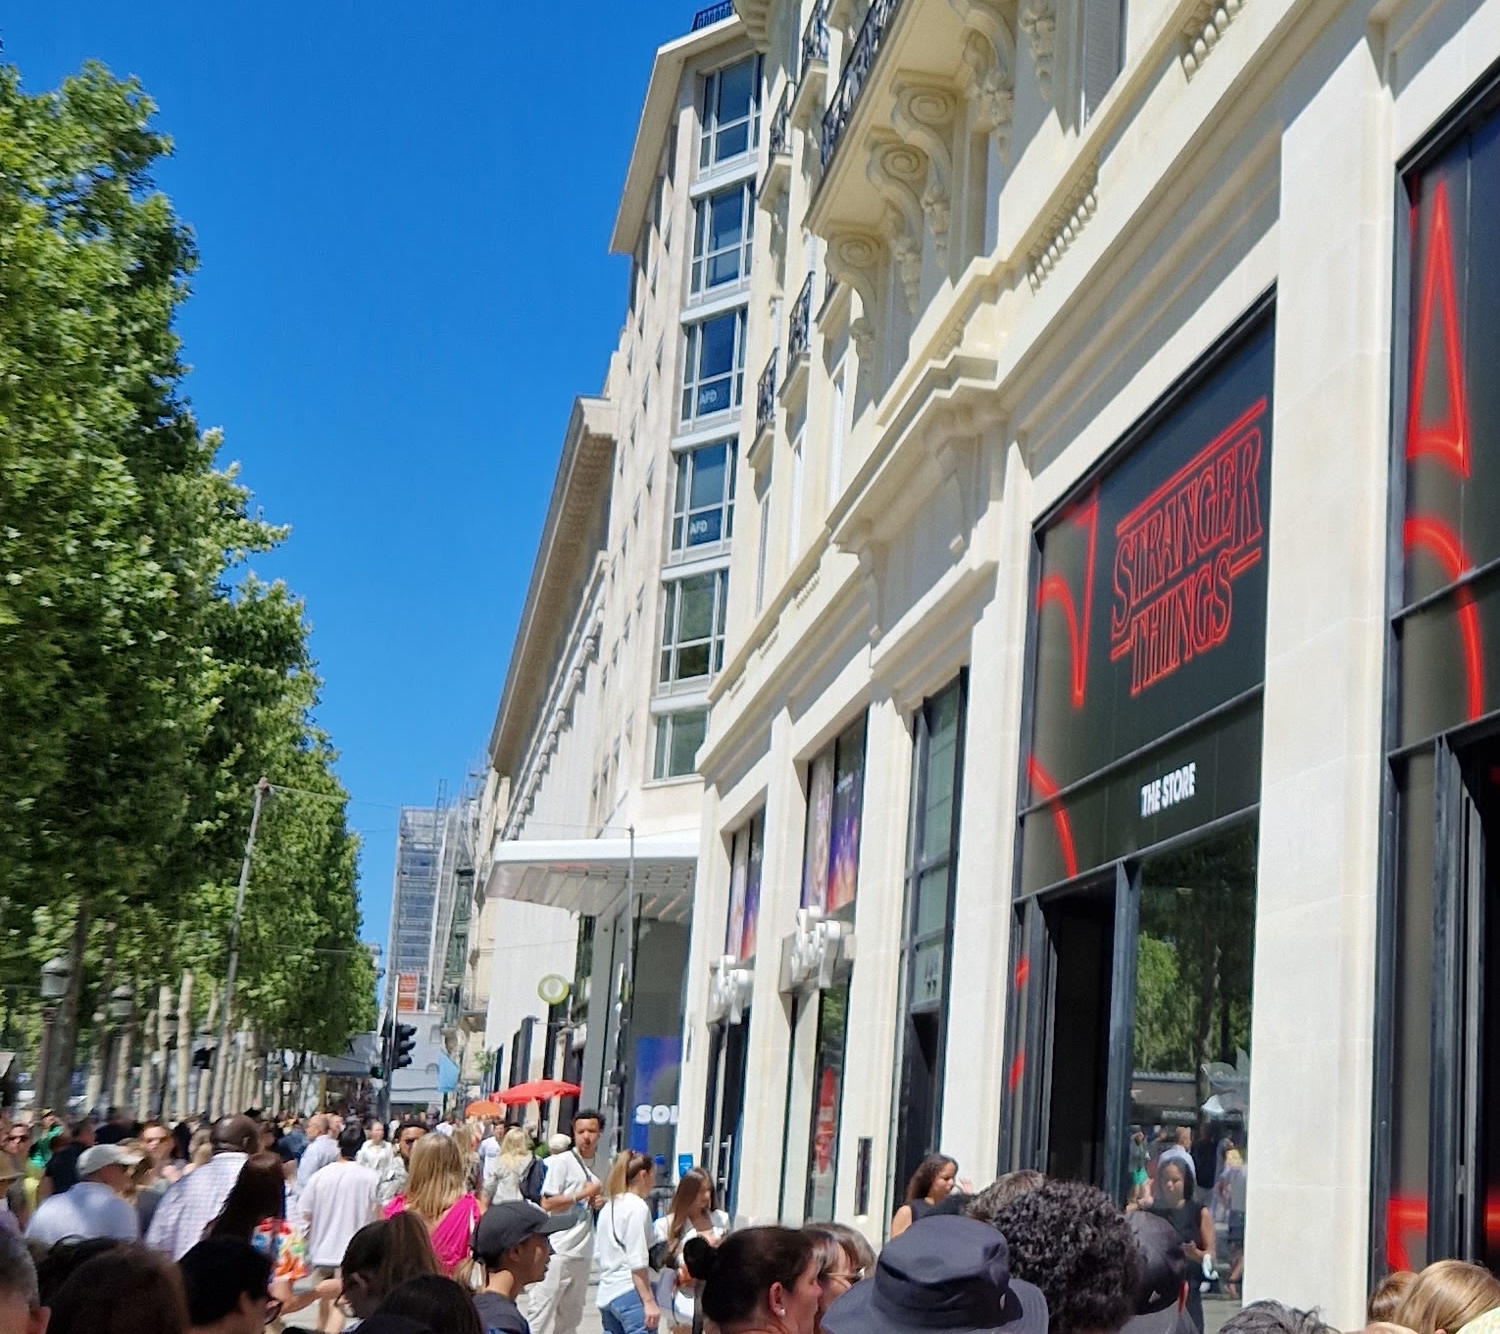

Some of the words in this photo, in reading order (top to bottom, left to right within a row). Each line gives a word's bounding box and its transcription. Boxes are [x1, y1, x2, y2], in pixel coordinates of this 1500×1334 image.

[1111, 427, 1263, 642] STRANGER
[1130, 546, 1233, 699] THINGS
[1141, 779, 1161, 818] THE
[1161, 762, 1196, 809] STORE
